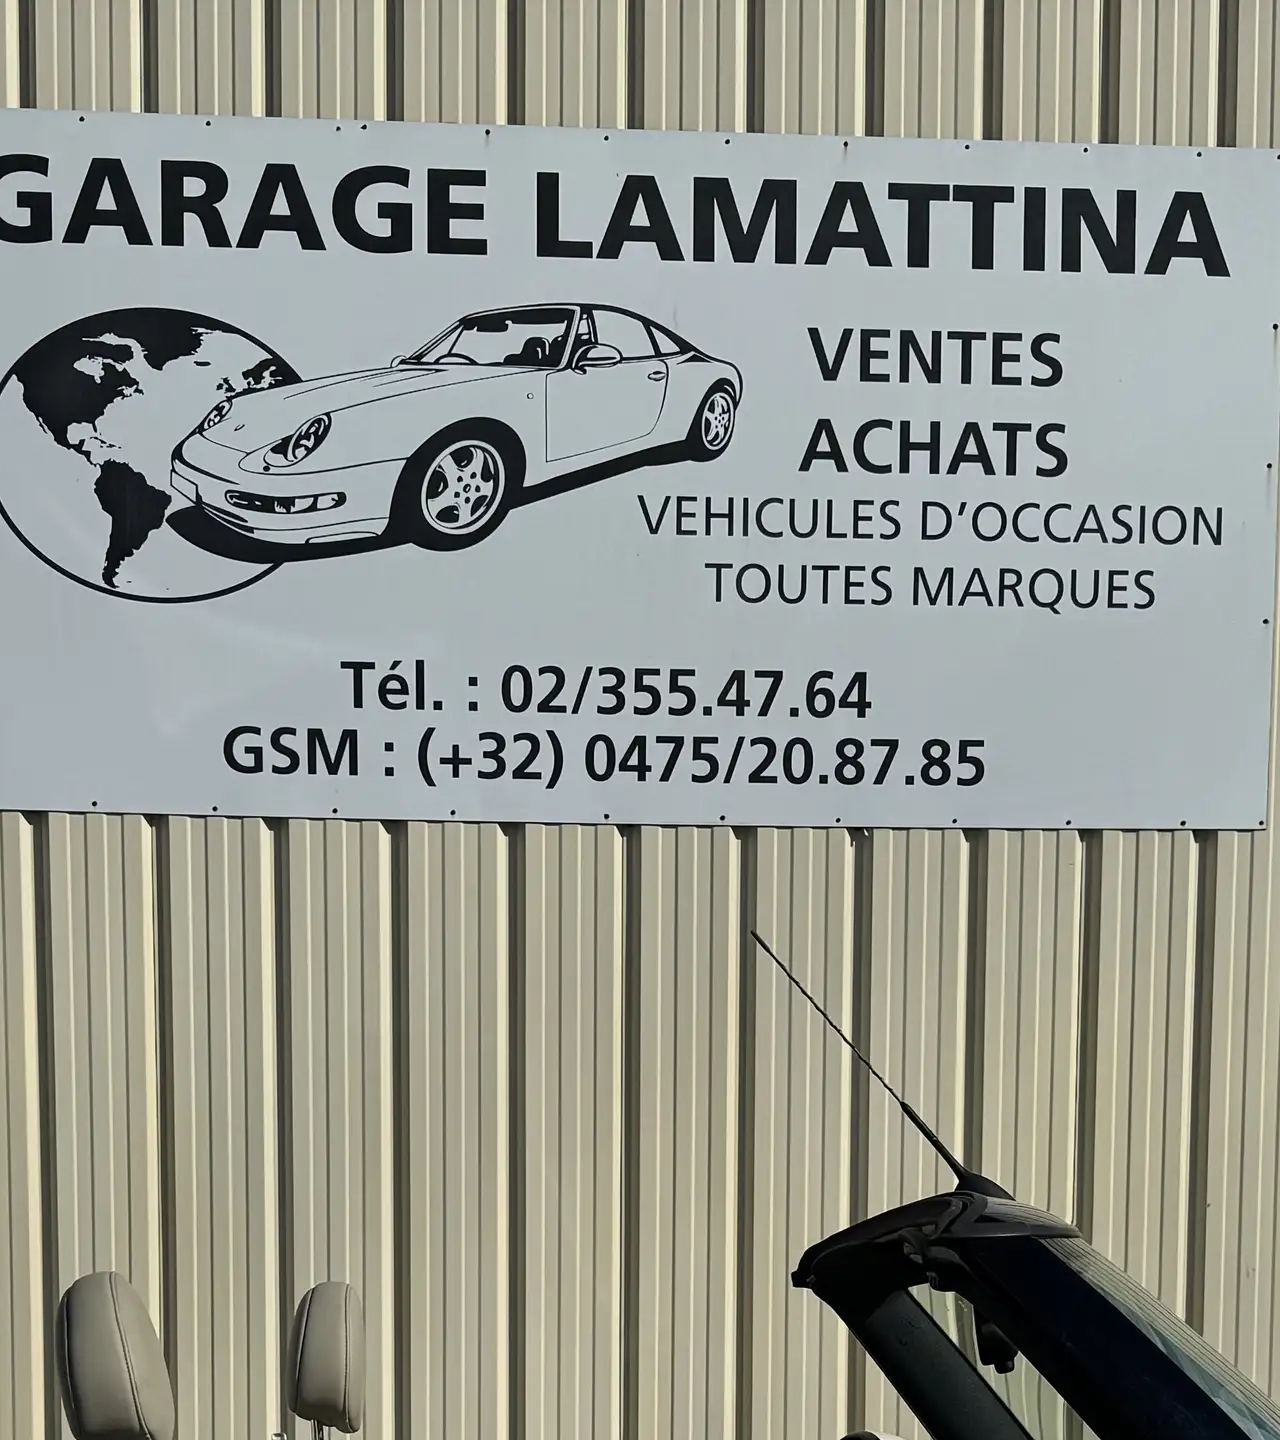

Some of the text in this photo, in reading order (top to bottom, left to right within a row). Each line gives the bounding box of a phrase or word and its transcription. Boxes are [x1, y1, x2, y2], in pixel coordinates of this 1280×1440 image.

[537, 172, 1230, 277] LAMATTINA
[807, 328, 1062, 387] VENTES
[799, 419, 1067, 477] ACHATS
[638, 495, 1222, 545] VEHICULES D'OCCASION
[705, 563, 1154, 614] TOUTES MARQUES
[341, 660, 442, 710] Tél.
[502, 665, 871, 718] 02/355.47.64
[224, 726, 358, 775] GSM
[418, 728, 563, 789] (+32)
[585, 734, 984, 786] 0475/20.87.85
